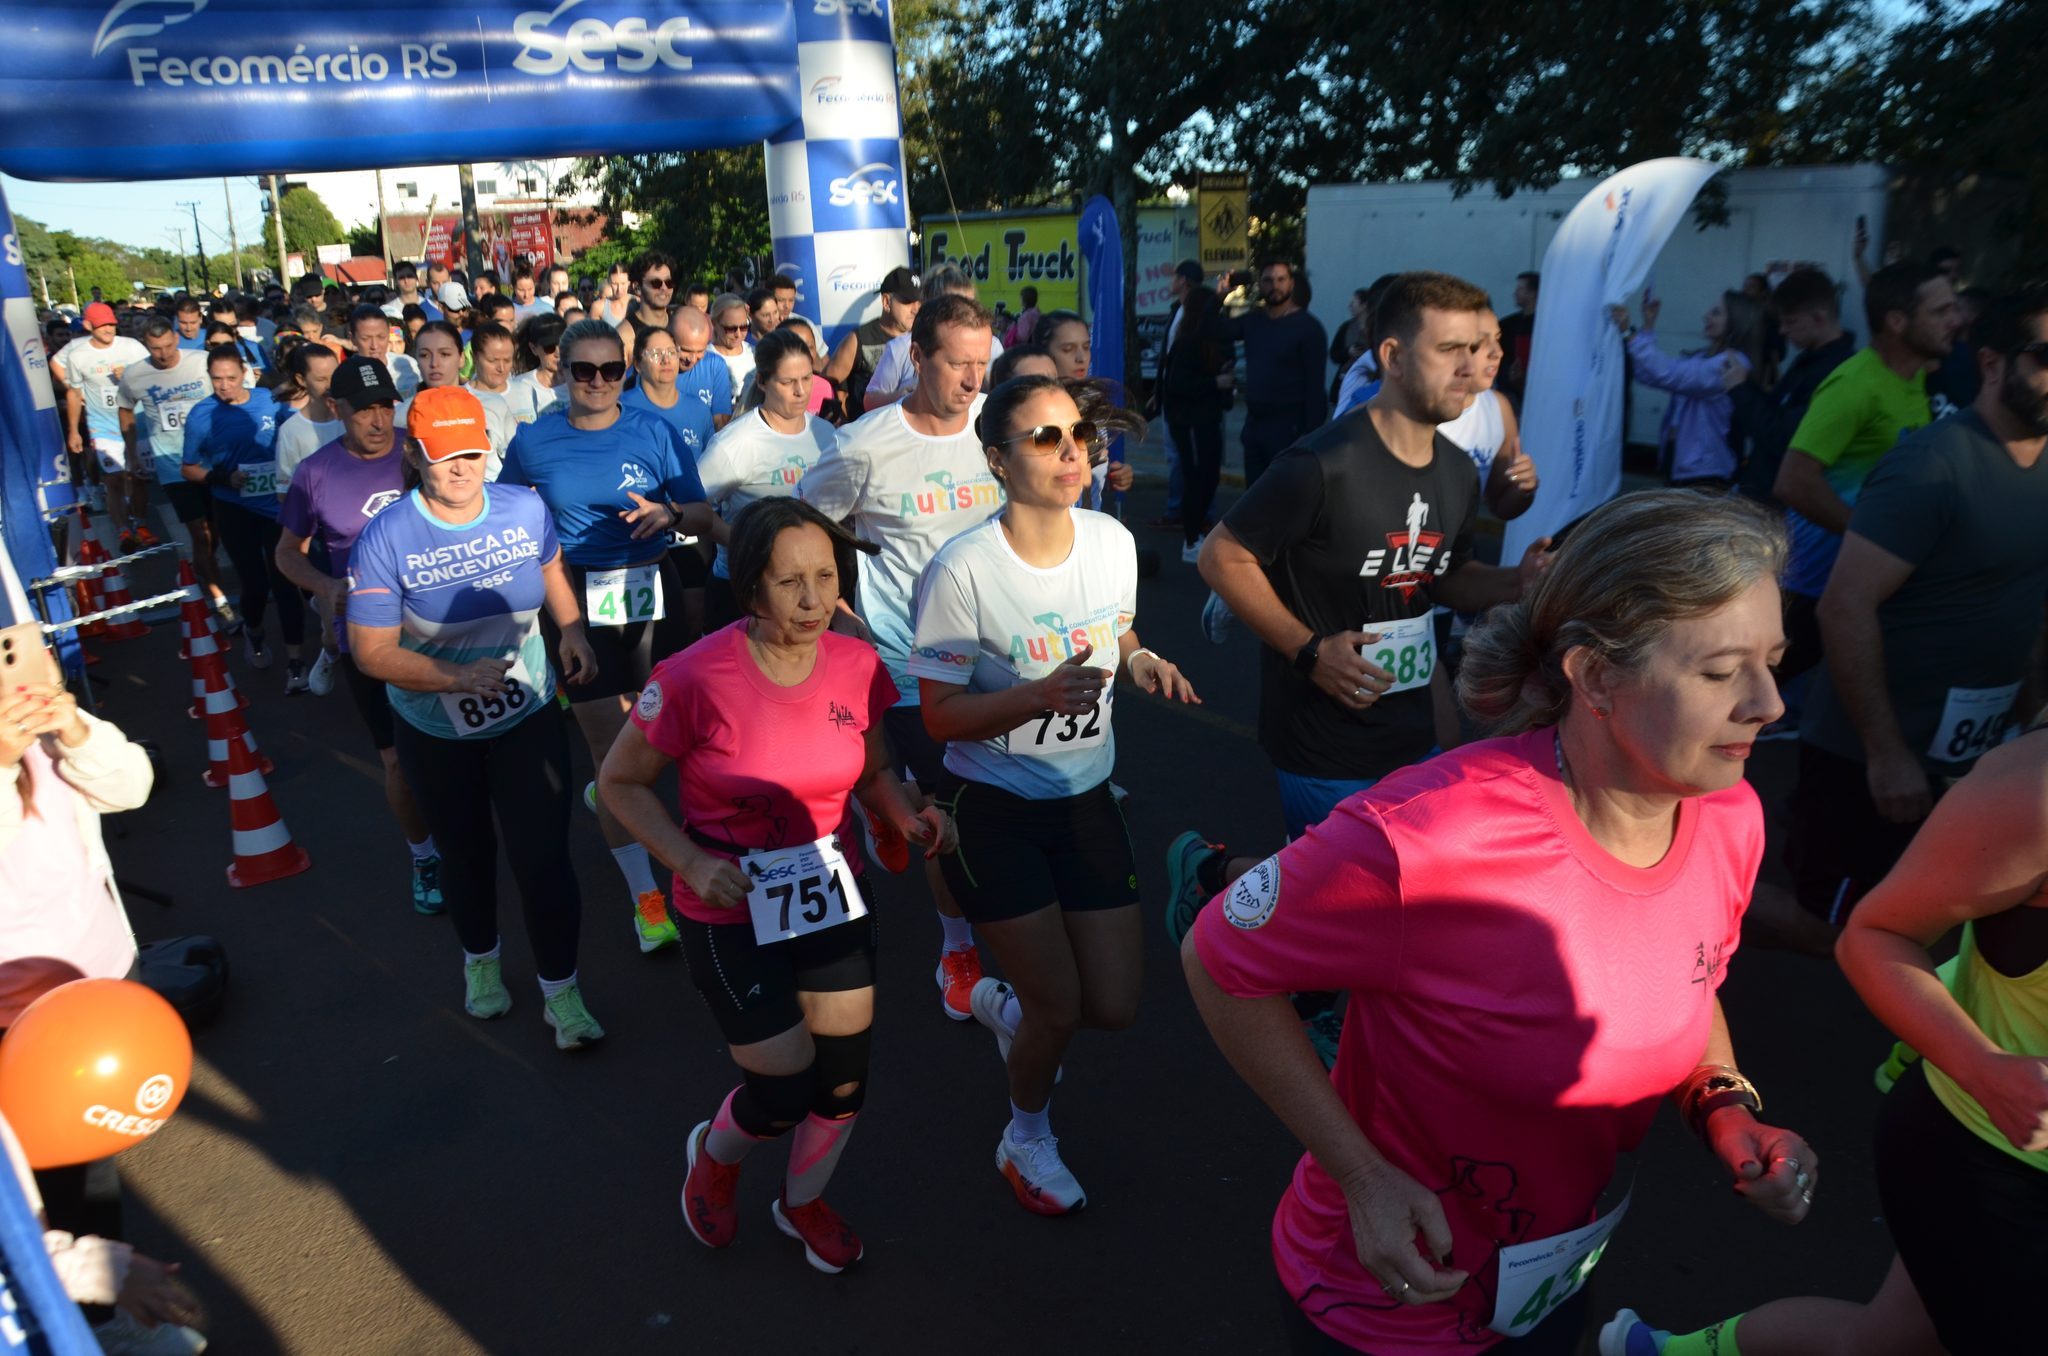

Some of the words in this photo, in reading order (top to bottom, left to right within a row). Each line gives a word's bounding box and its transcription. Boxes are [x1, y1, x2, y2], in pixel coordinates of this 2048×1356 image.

[127, 43, 389, 87] Fecomércio
[401, 42, 457, 80] RS
[1004, 229, 1076, 281] Truck
[402, 541, 540, 589] LONGEVIDADE
[405, 534, 502, 571] RÚSTICA
[502, 526, 530, 545] DA
[472, 570, 514, 592] sesc
[598, 587, 654, 619] 412
[1375, 640, 1432, 684] 383
[459, 677, 526, 728] 858
[1035, 702, 1100, 745] 732
[765, 868, 850, 932] 751
